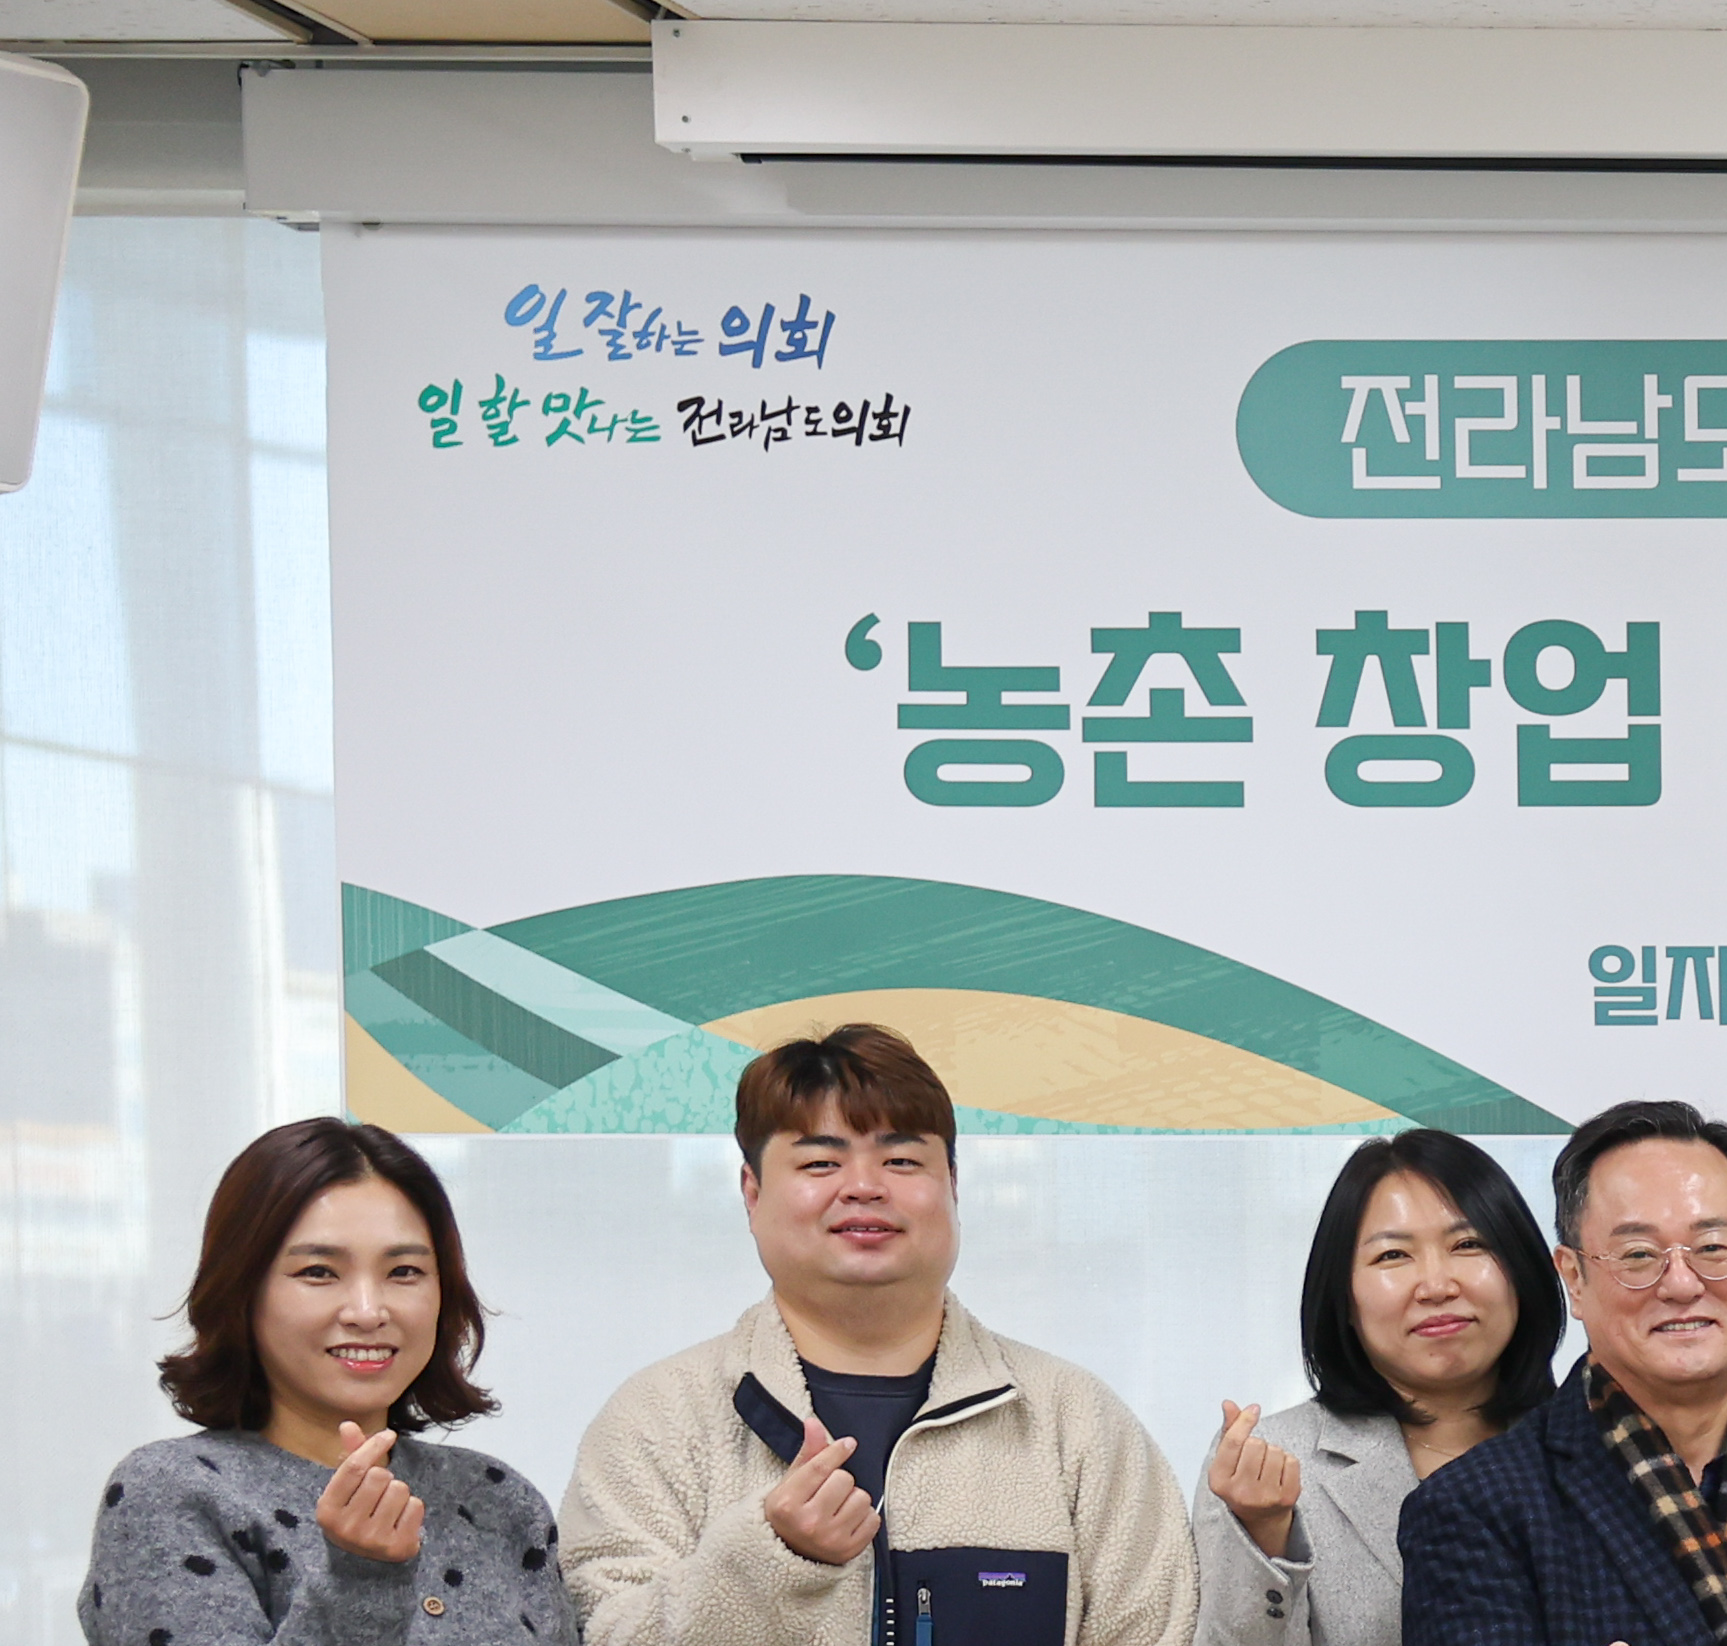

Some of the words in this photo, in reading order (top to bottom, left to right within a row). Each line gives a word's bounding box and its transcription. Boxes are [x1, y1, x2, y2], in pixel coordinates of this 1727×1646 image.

[583, 289, 704, 361] 잘하는
[719, 293, 836, 370] 의회
[677, 392, 911, 453] 전라남도의회
[1315, 610, 1662, 807] 창업
